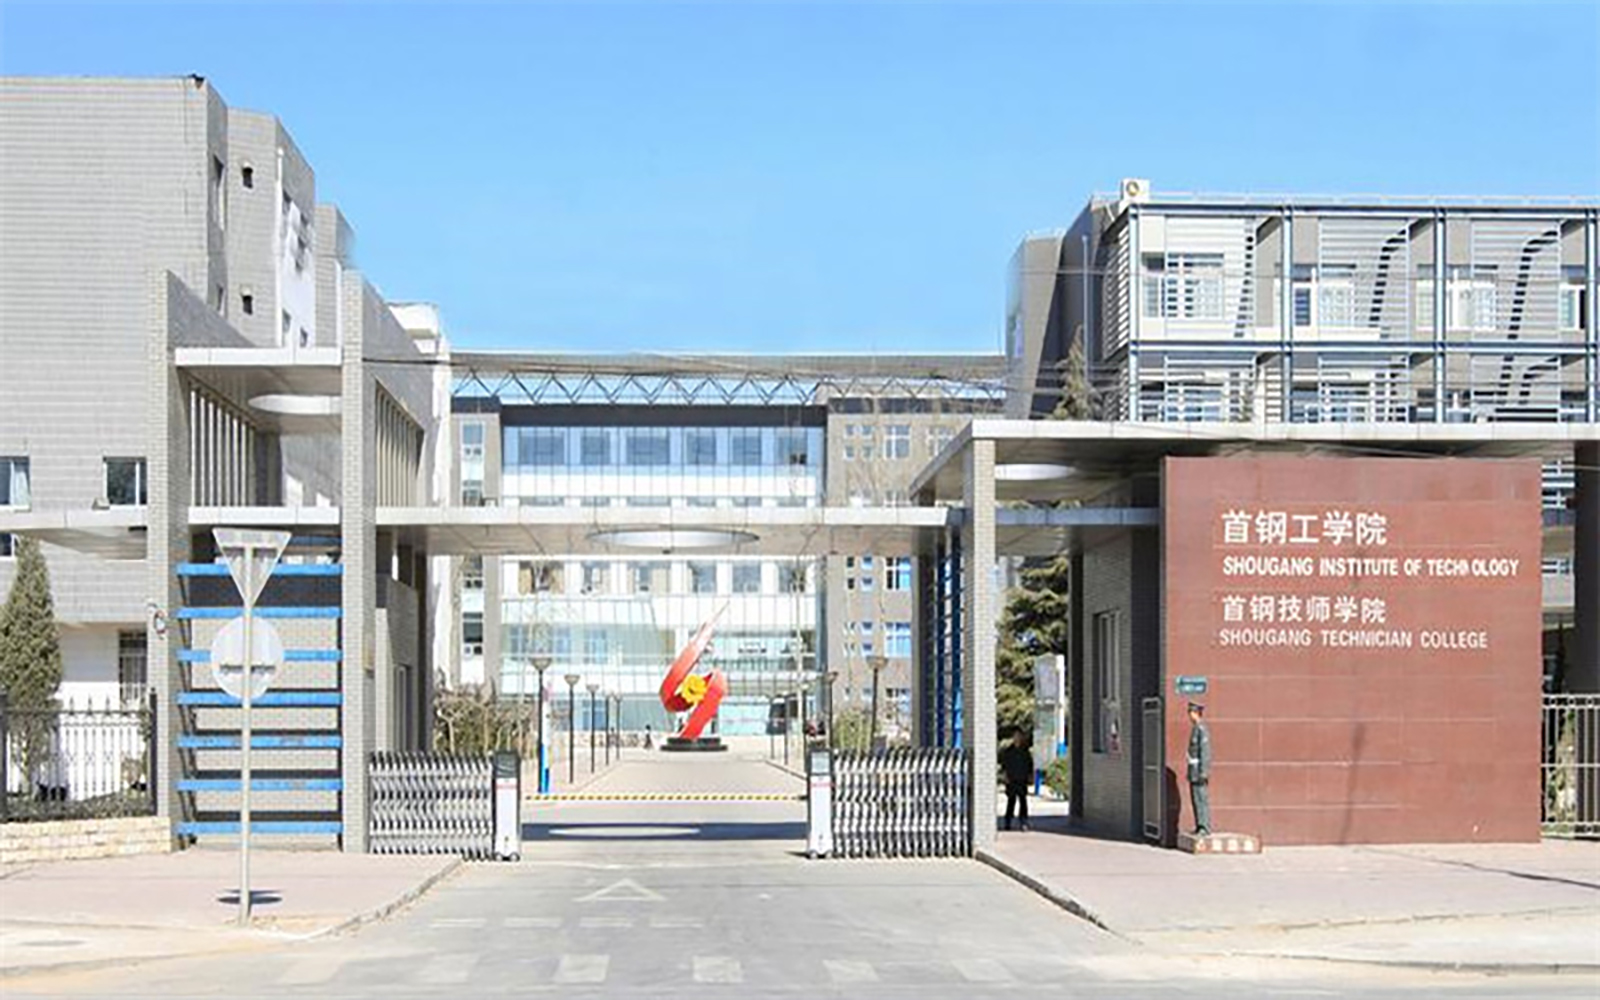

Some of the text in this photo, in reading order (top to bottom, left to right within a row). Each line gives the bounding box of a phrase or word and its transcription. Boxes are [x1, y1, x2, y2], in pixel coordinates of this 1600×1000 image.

[1221, 509, 1388, 546] 首钢工学院
[1222, 557, 1314, 577] SHOUGANG
[1319, 558, 1399, 577] INSTITUTE
[1403, 558, 1422, 577] OF
[1221, 595, 1387, 624] 首钢技师学院
[1219, 628, 1489, 649] SHOUGANG TECHNICIAN COLLEGE
